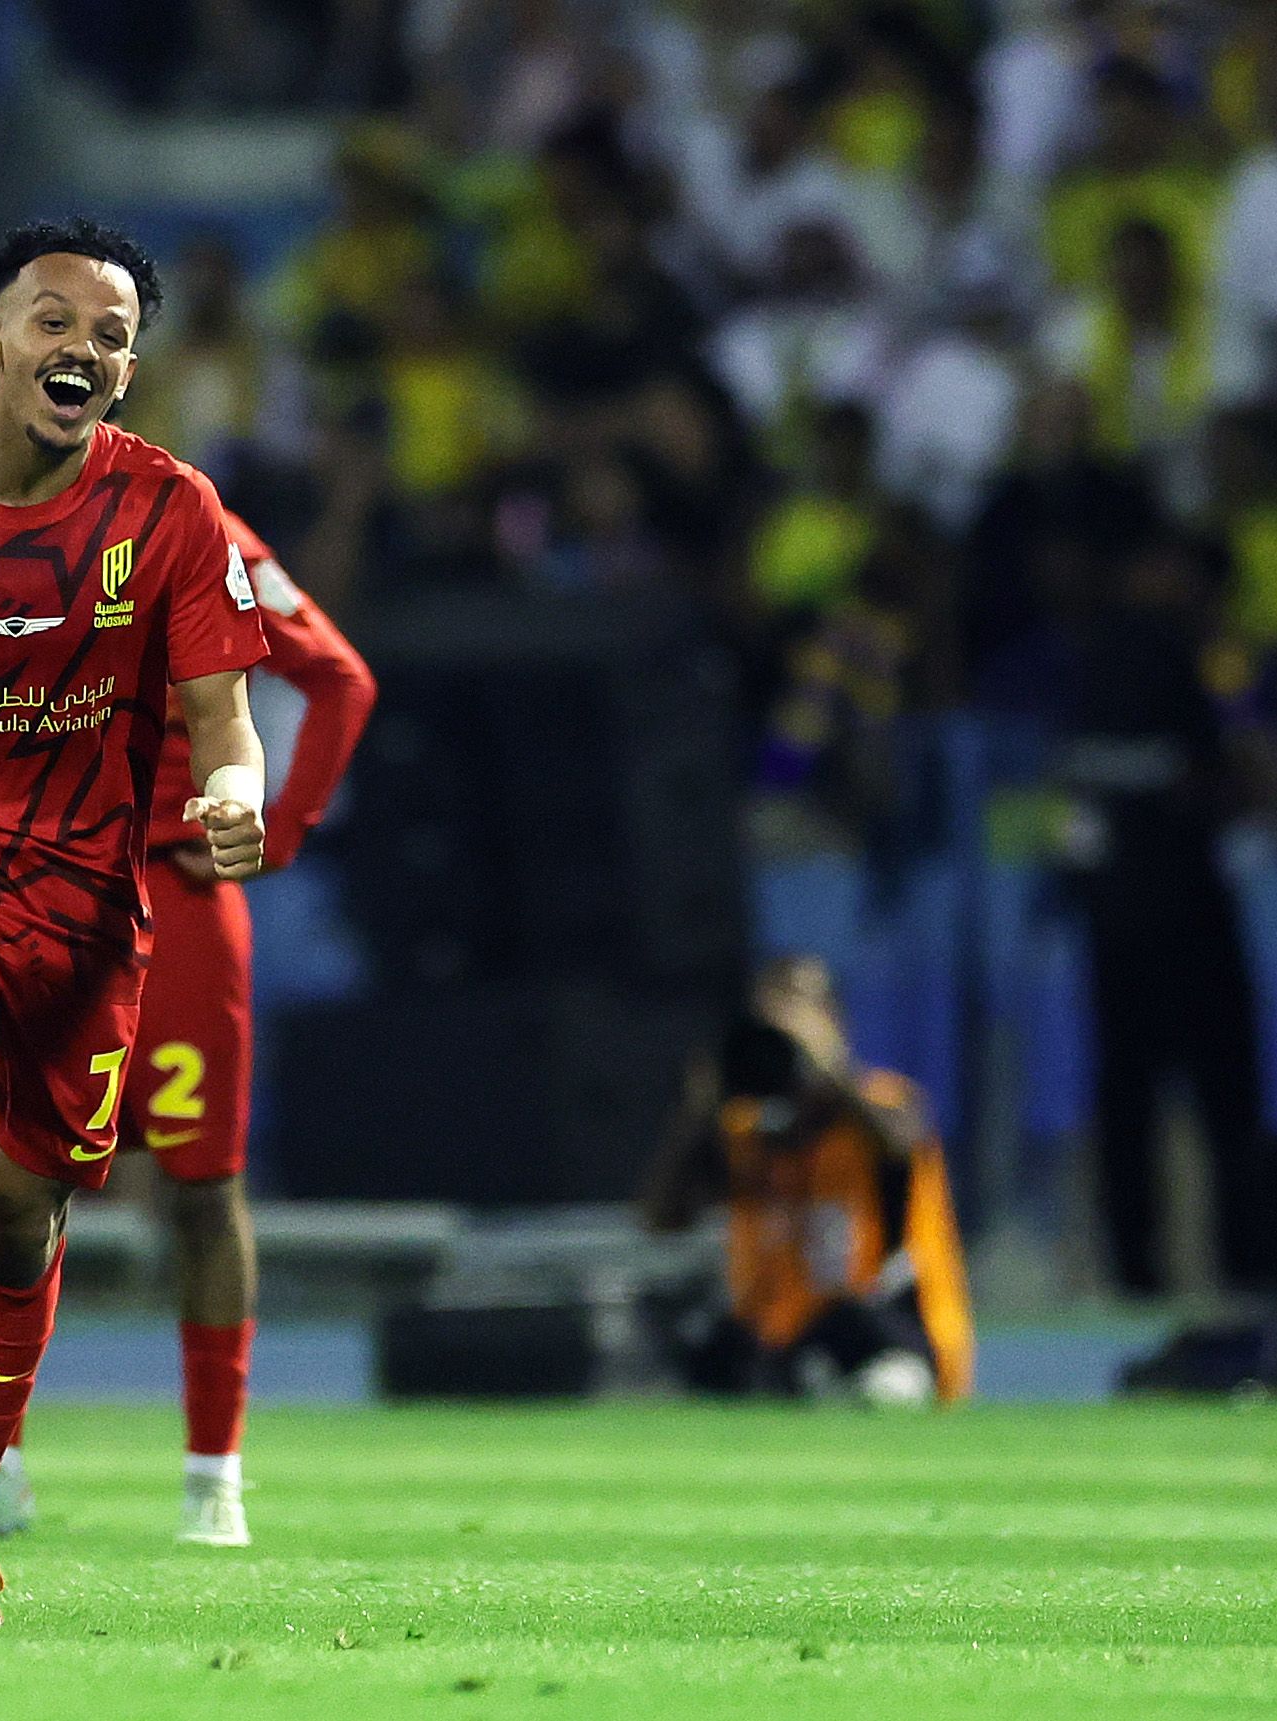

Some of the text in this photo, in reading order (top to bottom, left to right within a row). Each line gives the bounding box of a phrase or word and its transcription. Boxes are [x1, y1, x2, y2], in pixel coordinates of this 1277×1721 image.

[35, 706, 112, 734] Aviation
[49, 675, 115, 713] الأولى
[85, 1046, 127, 1131] 7
[147, 1040, 205, 1119] 2
